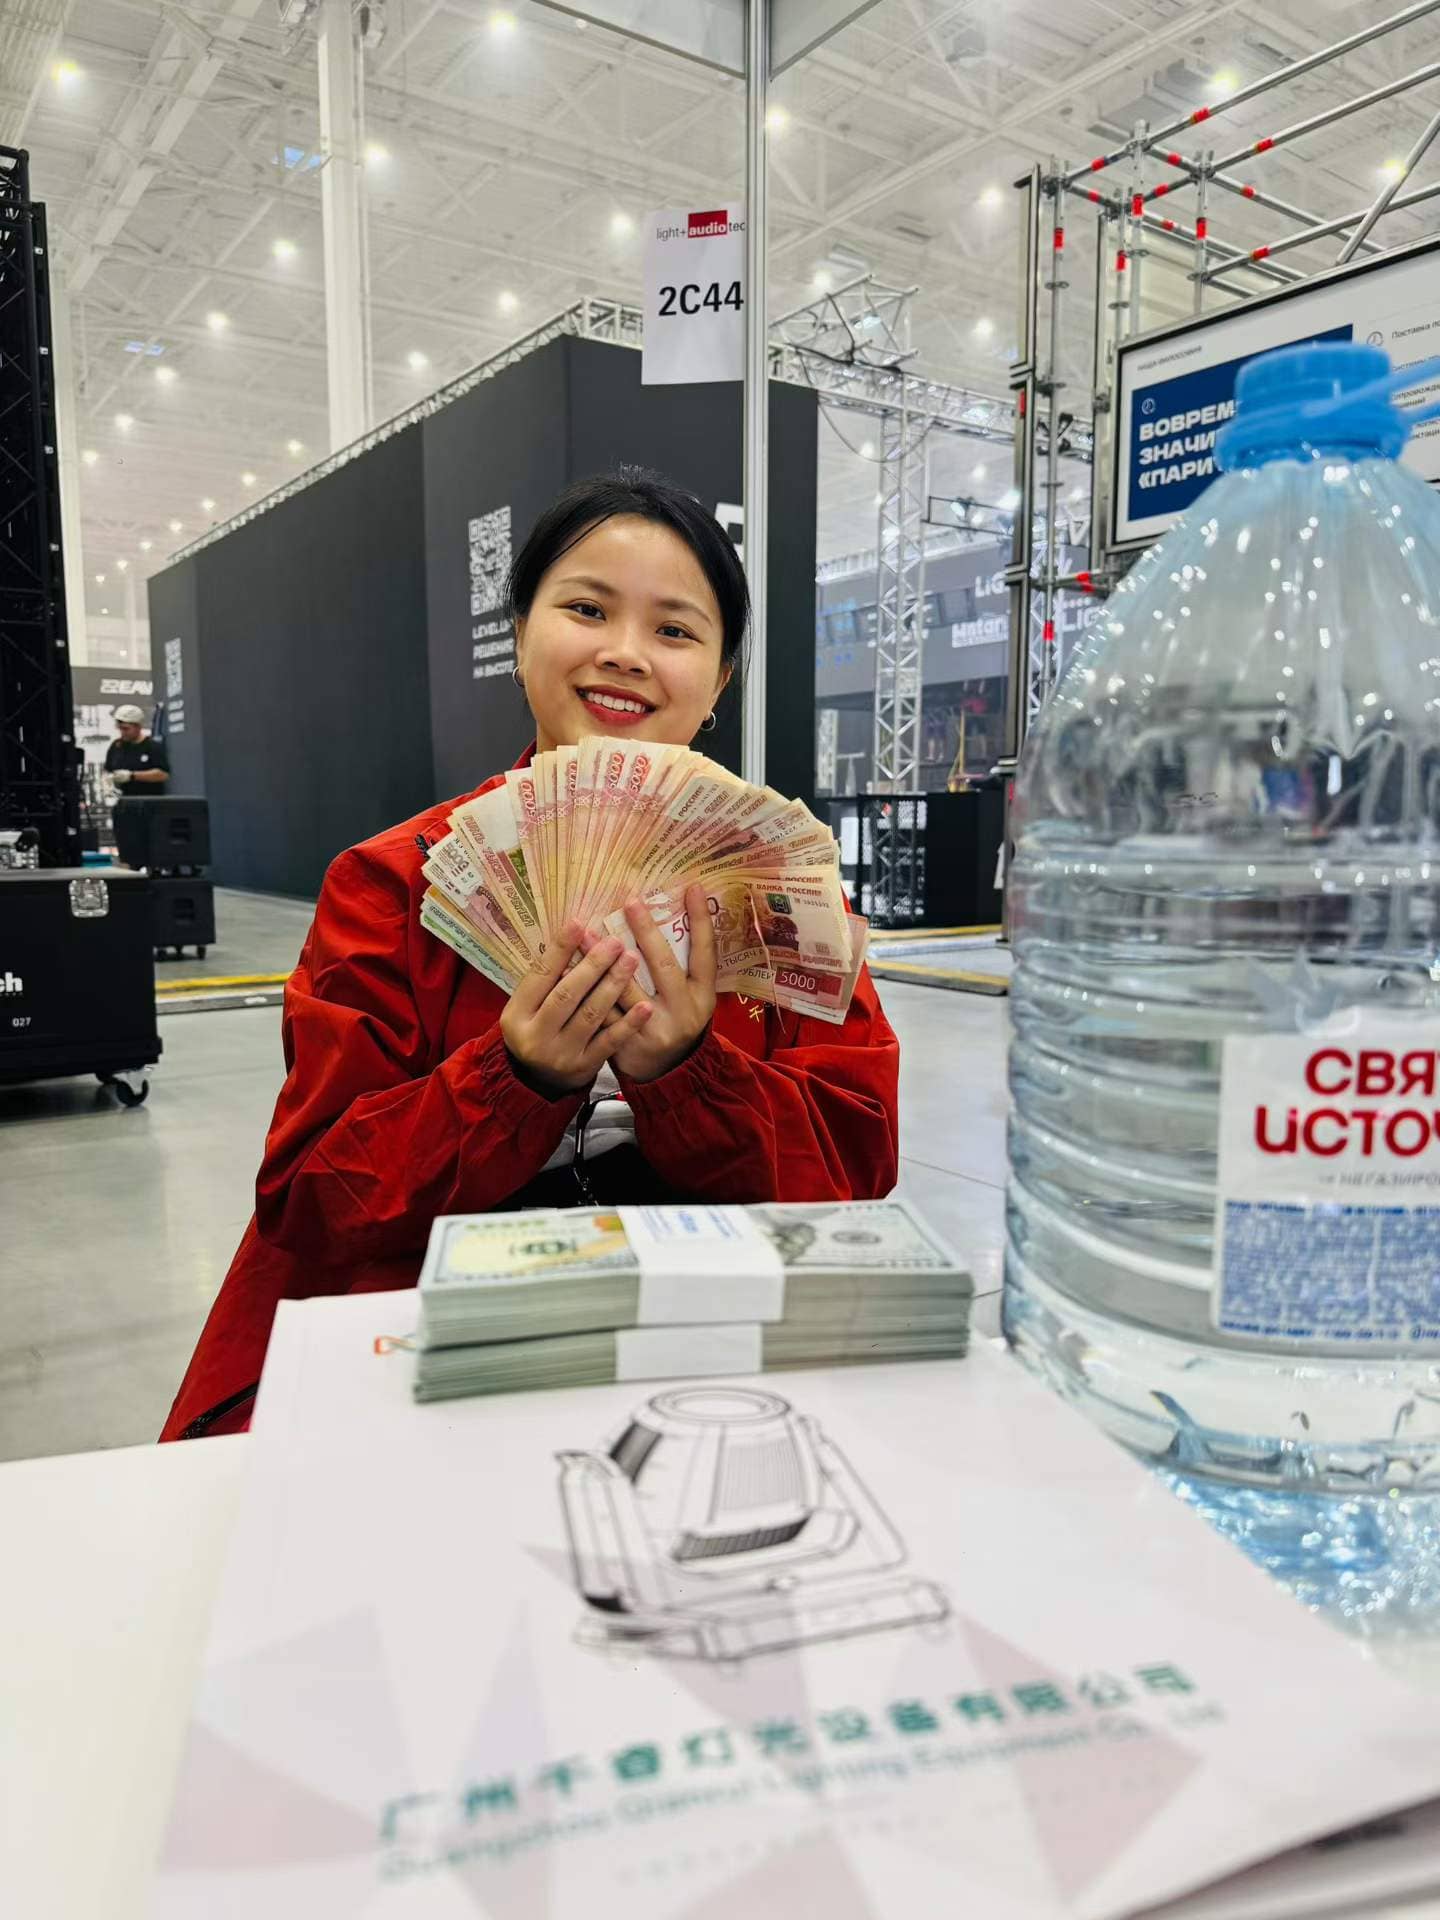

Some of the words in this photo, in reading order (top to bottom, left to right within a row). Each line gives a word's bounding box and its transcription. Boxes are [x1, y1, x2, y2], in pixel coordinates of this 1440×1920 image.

[658, 281, 745, 316] 2C44
[1139, 399, 1236, 441] ВОВРЕМ
[1139, 431, 1216, 465] ЗНАЧИ
[1138, 457, 1214, 489] «ПАРИ
[607, 751, 625, 788] 5000
[630, 755, 648, 793] 5000
[518, 780, 537, 817] 5000
[724, 950, 756, 967] ТЫСЯЧ
[780, 971, 816, 990] 5000
[12, 1016, 31, 1027] 027
[1304, 1047, 1440, 1097] СВЯ
